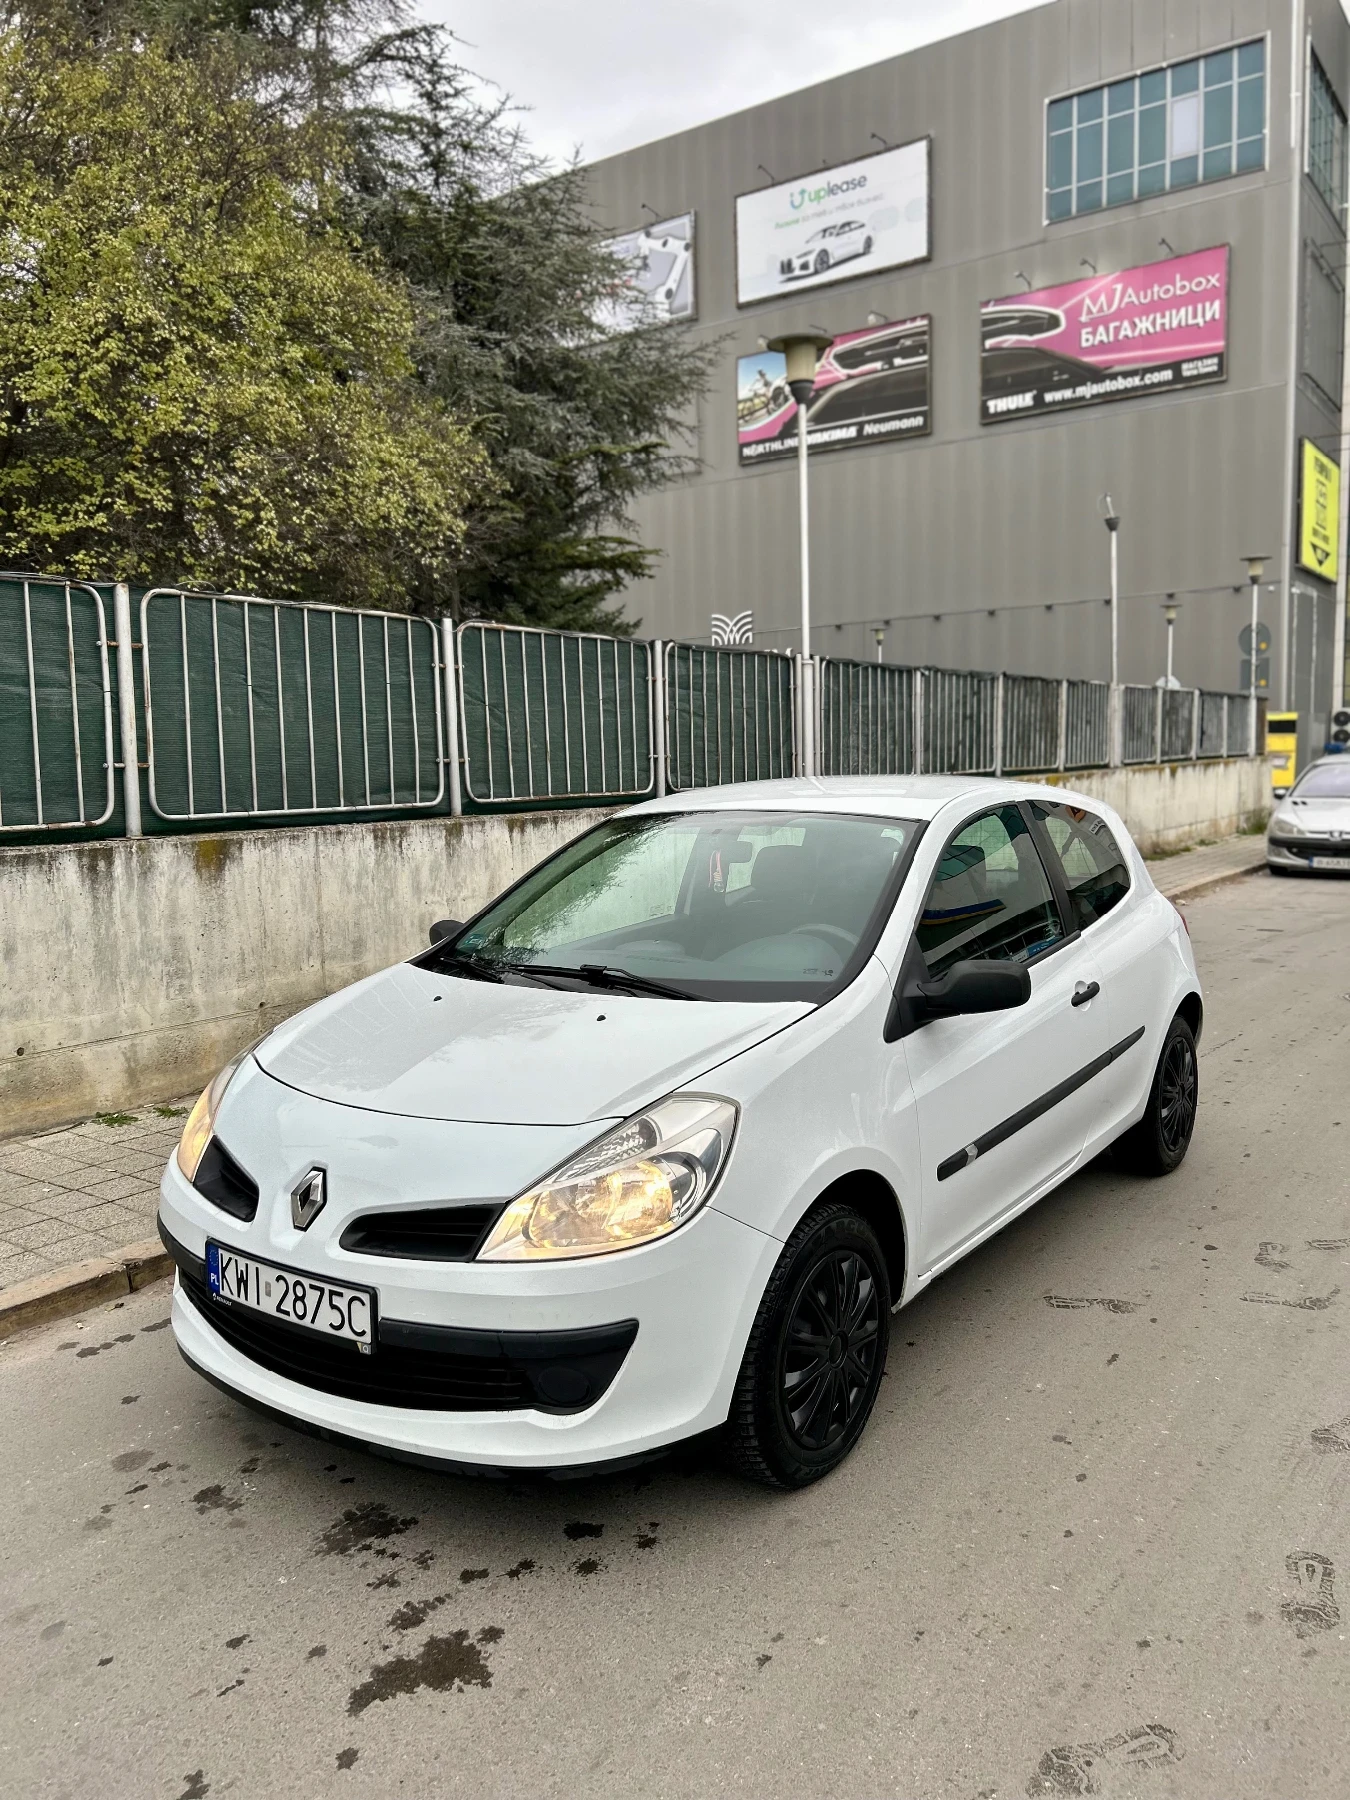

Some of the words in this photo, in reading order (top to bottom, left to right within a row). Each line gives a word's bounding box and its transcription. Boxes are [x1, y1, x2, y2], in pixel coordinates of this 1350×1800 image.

[808, 175, 867, 204] uplease
[1081, 299, 1220, 348] БАГАЖНИЦИ
[987, 391, 1035, 414] THULE
[1043, 368, 1173, 403] www.mjautobox.com
[862, 415, 924, 436] Neumann
[210, 1272, 220, 1286] PL
[220, 1253, 260, 1306] KWI
[275, 1274, 367, 1337] 2875C
